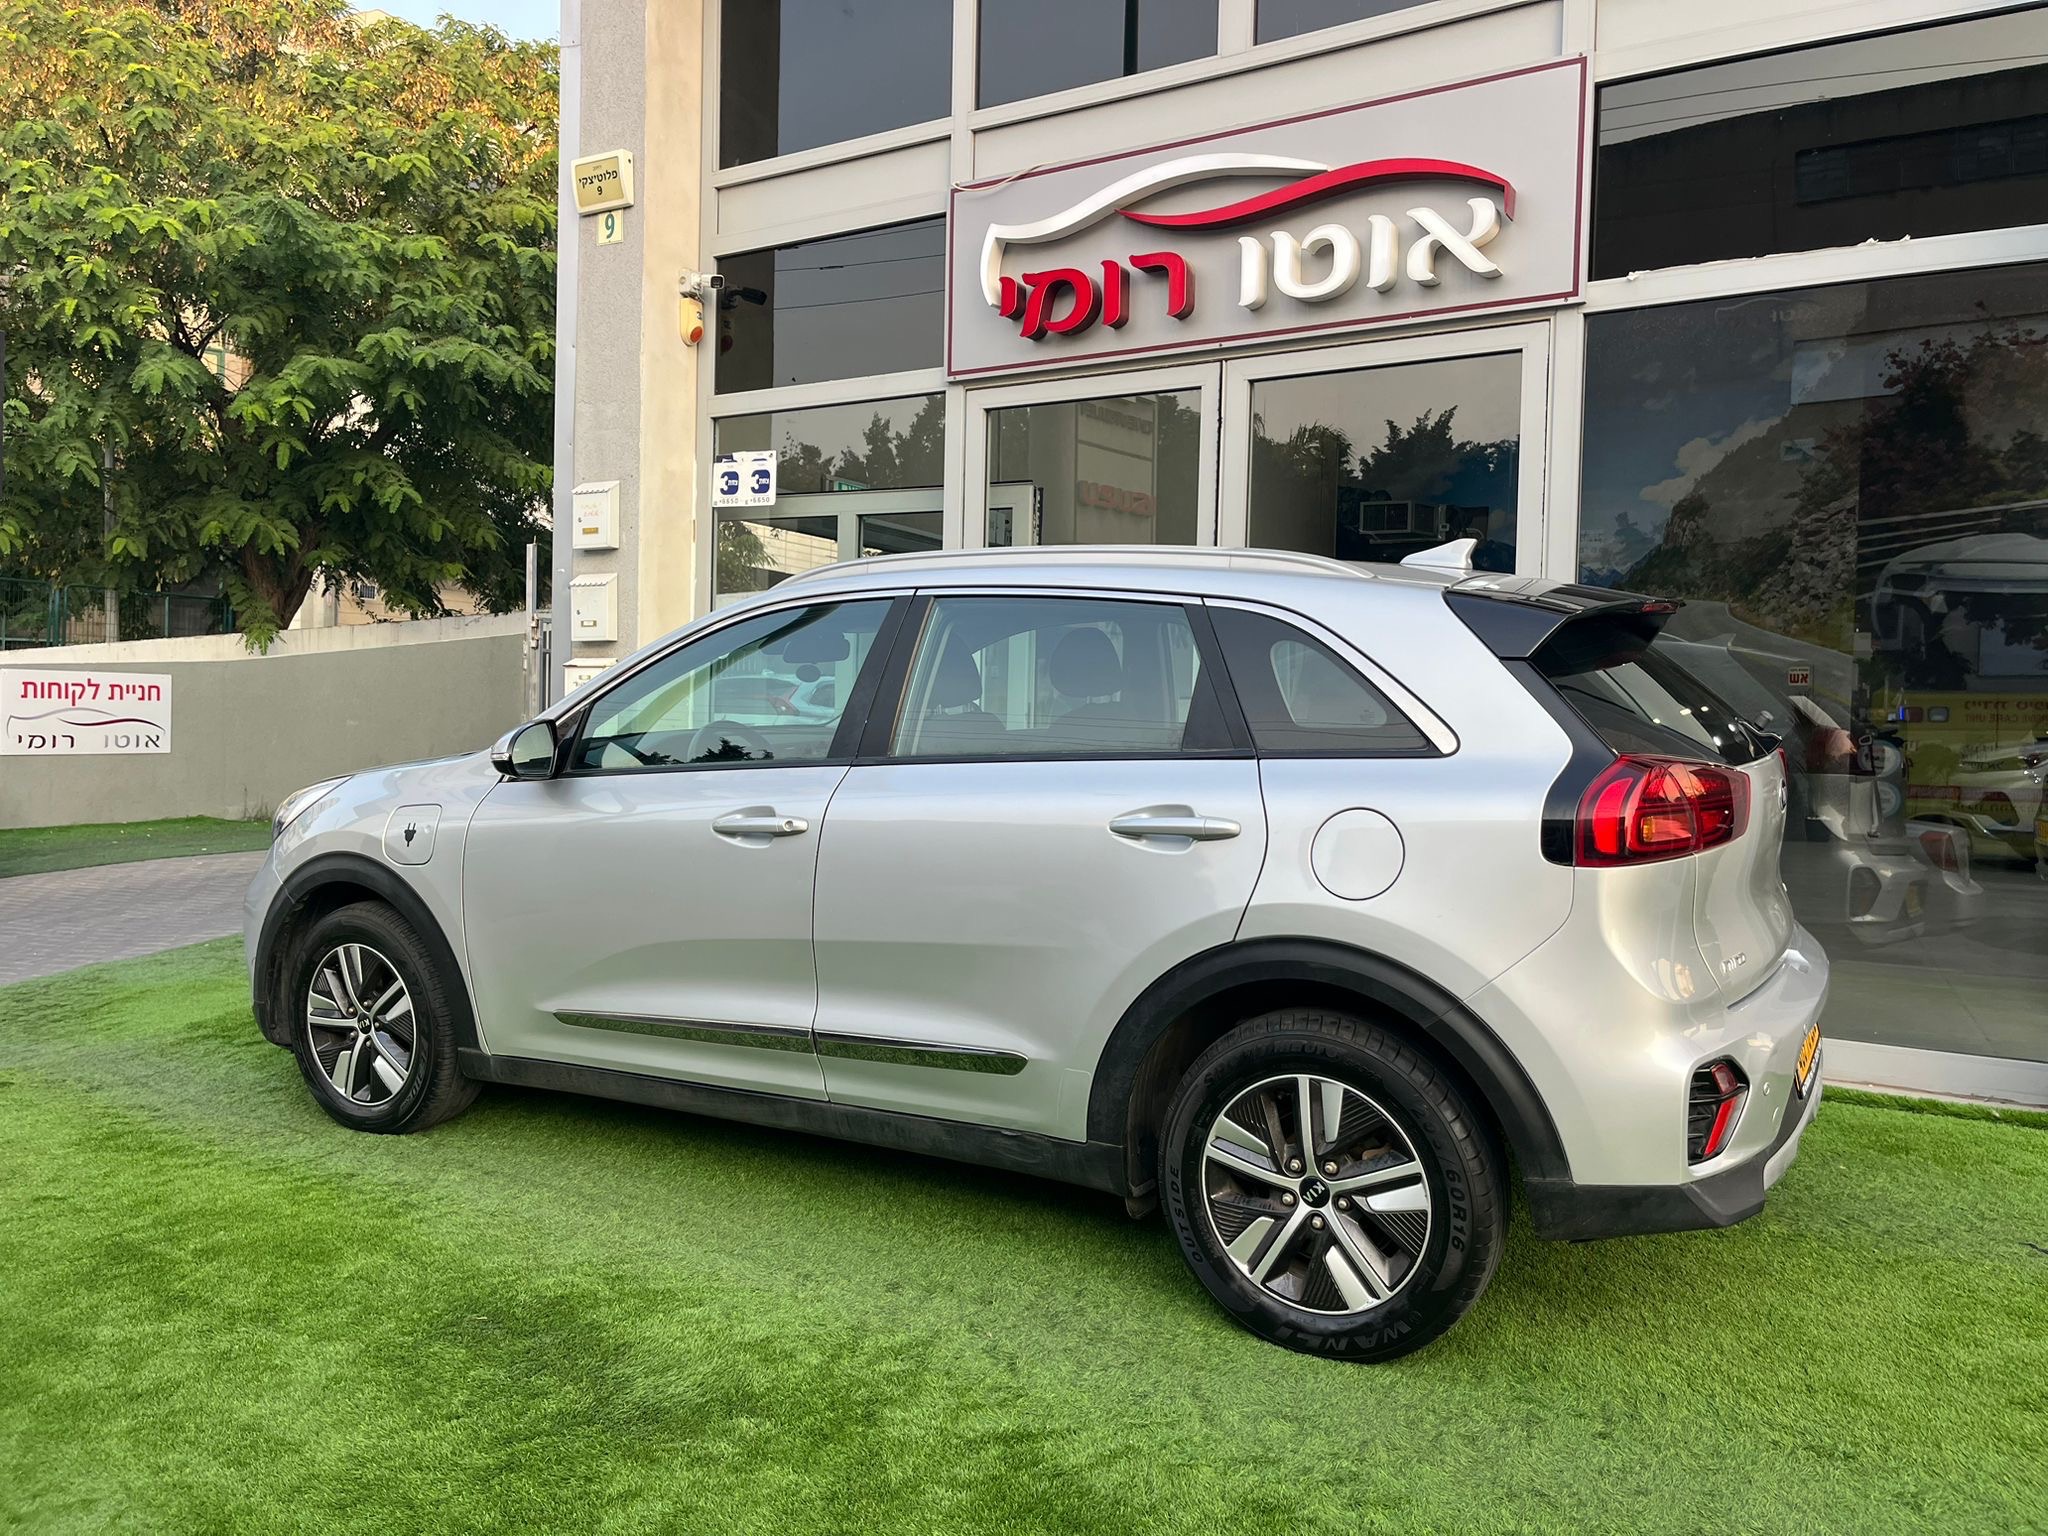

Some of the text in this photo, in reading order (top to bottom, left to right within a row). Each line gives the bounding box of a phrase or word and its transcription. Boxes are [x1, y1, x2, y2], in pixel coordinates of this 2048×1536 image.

[578, 169, 618, 189] פלוטיצקי
[596, 185, 603, 196] 9
[604, 213, 615, 239] 9
[999, 197, 1504, 342] אוטו רומי
[1789, 673, 1809, 684] אש
[20, 678, 161, 707] חניית לקוחות
[17, 734, 161, 749] אוטו רומי
[1302, 1181, 1326, 1203] KIA
[1167, 1166, 1205, 1265] OUTSIDE
